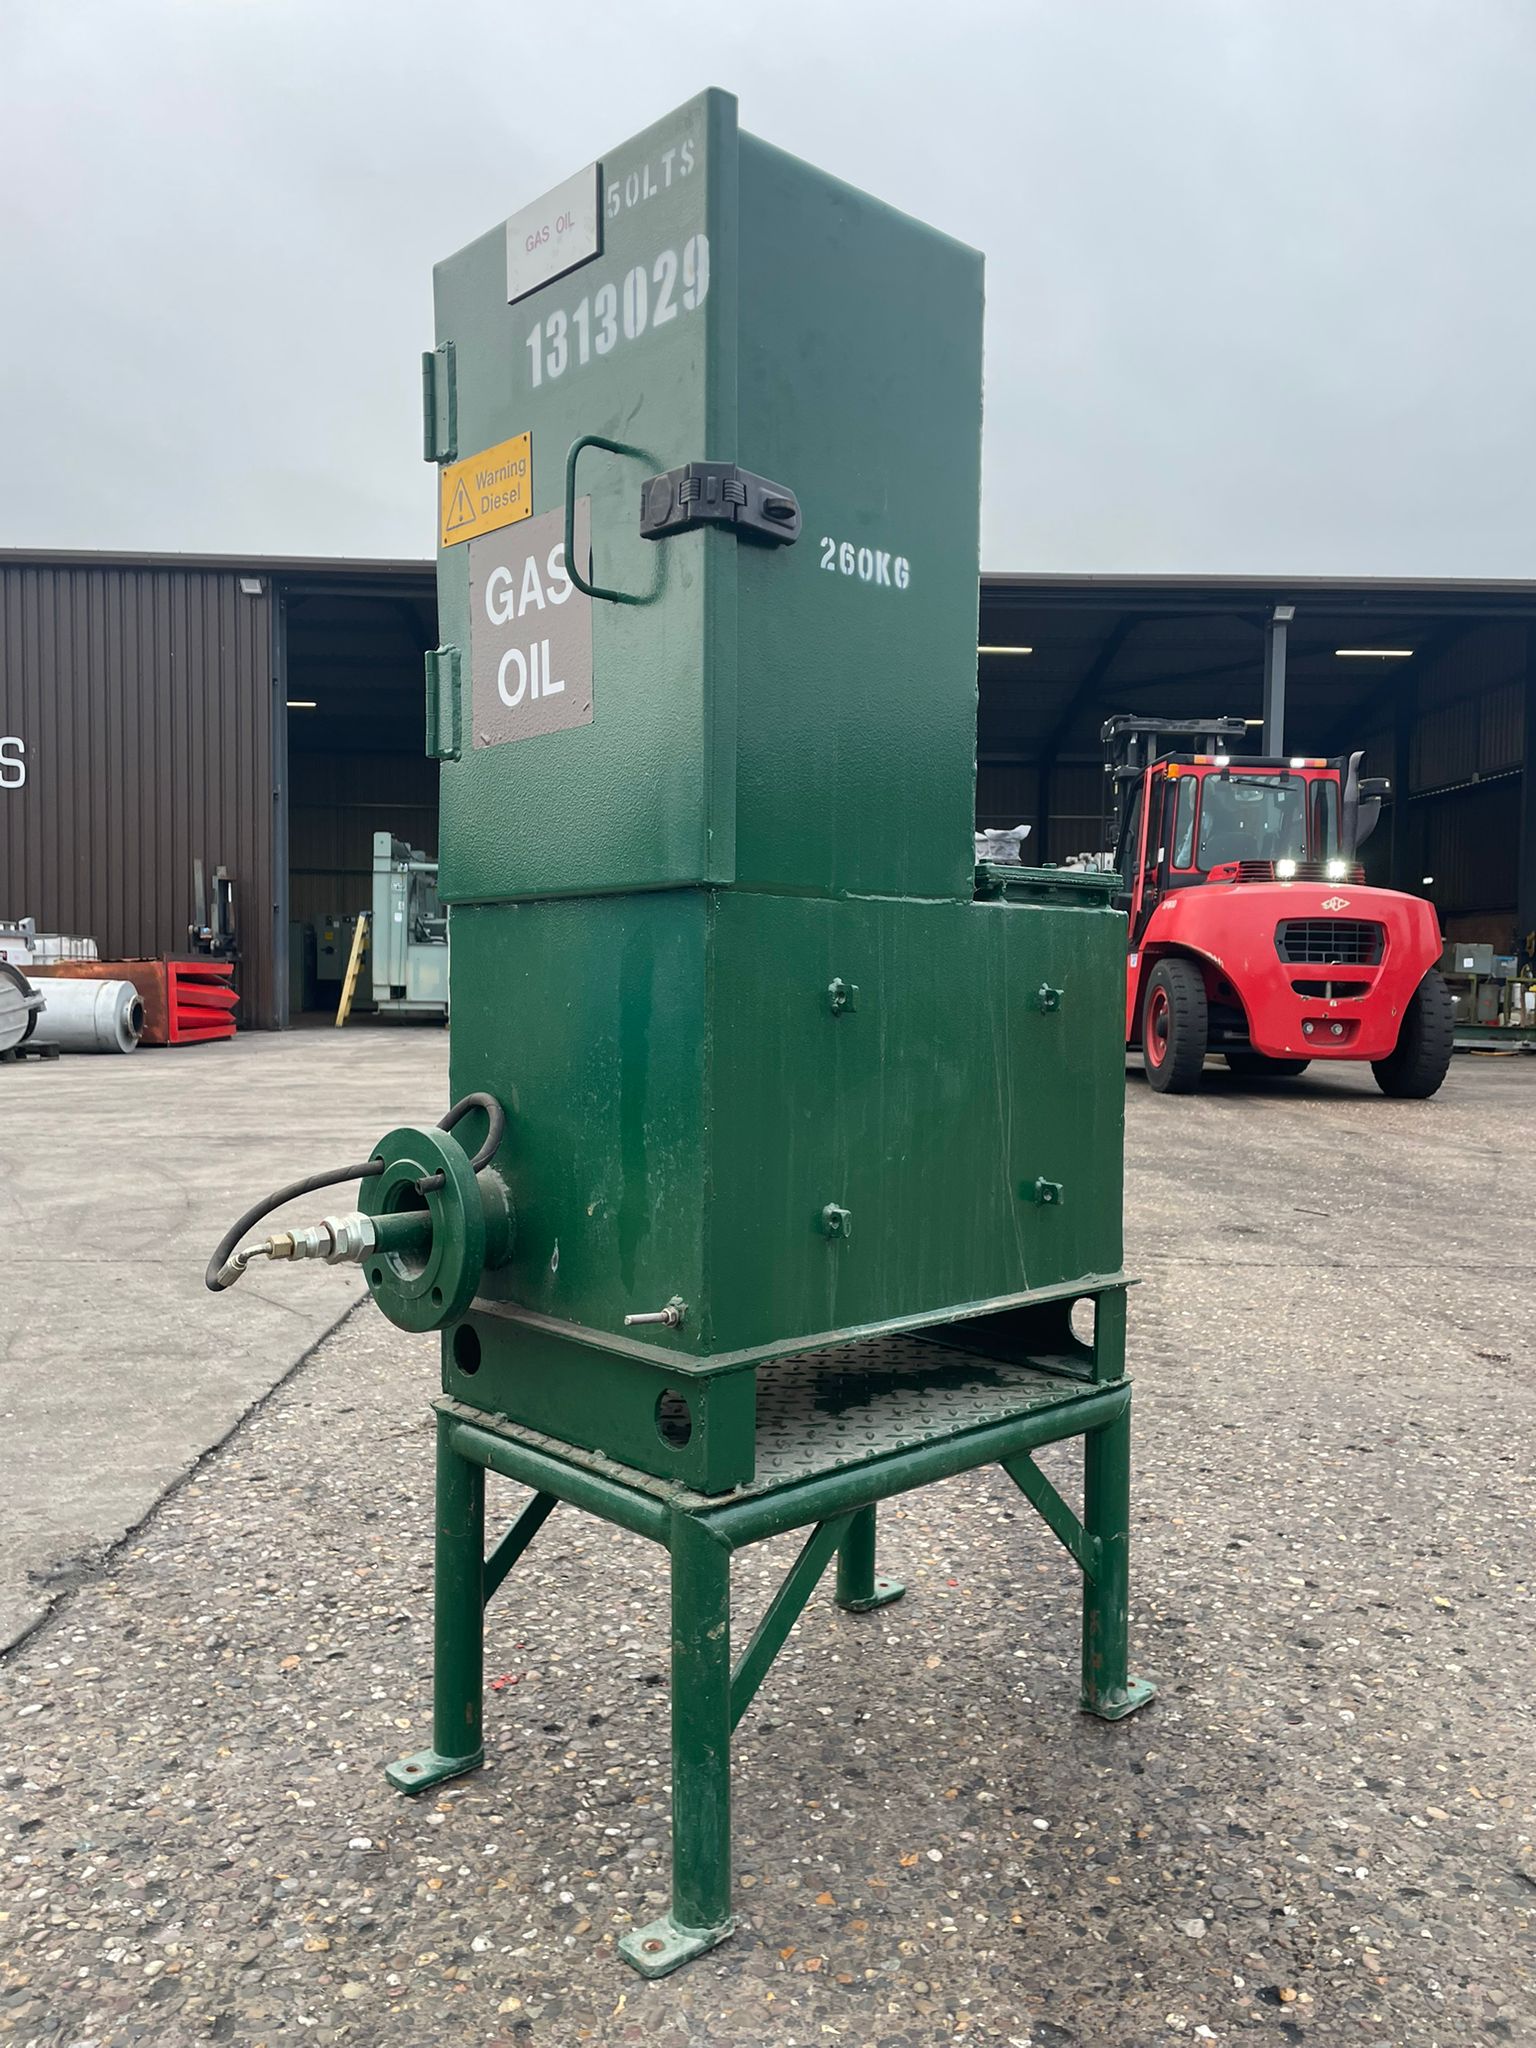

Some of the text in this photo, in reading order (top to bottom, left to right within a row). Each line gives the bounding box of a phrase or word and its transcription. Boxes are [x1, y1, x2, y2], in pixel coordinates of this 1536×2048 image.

[606, 138, 695, 218] 50LTS
[525, 211, 575, 252] GAS OIL
[526, 233, 710, 388] 1313029
[475, 457, 527, 490] Warning
[480, 482, 521, 514] Diesel
[485, 542, 574, 626] GAS
[820, 536, 910, 590] 260KG
[497, 638, 565, 707] OIL
